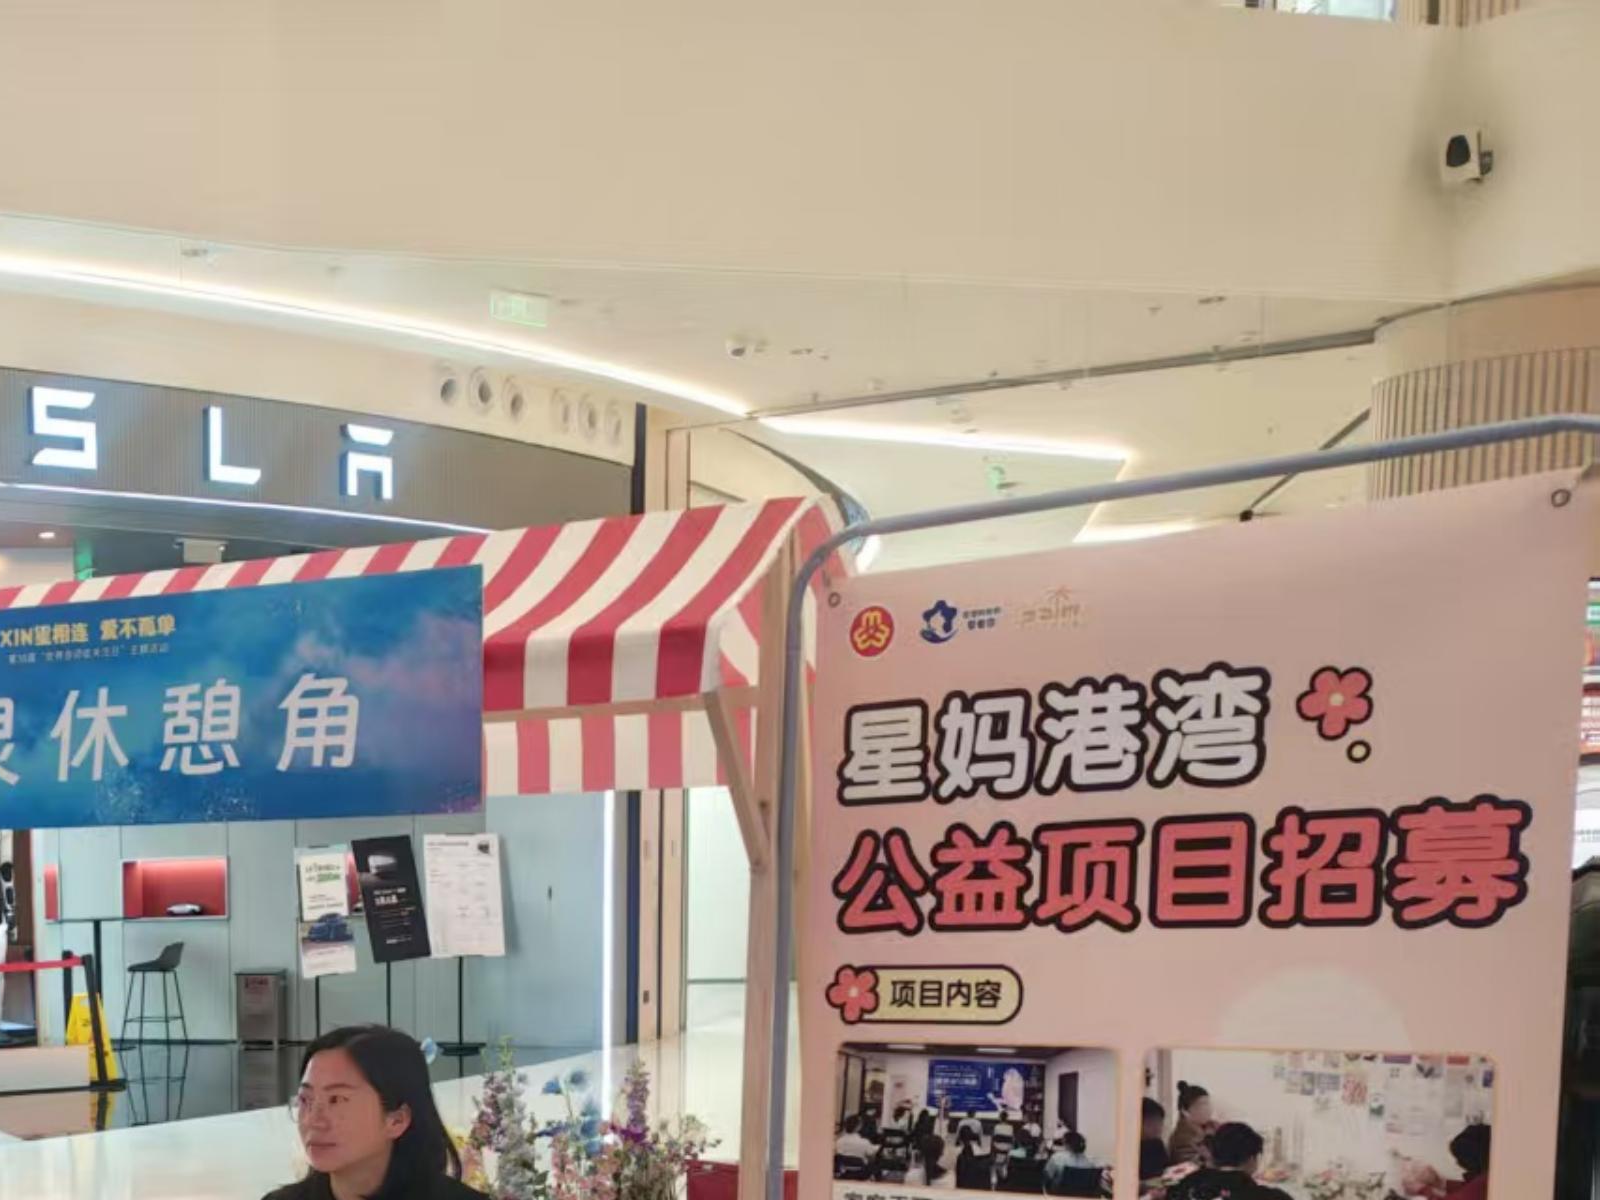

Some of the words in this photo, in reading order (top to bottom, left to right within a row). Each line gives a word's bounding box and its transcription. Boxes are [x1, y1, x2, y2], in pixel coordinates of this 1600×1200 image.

[838, 662, 1270, 806] 星妈港湾
[832, 794, 1532, 936] 公益项目招募
[890, 978, 1003, 1009] 项目内容
